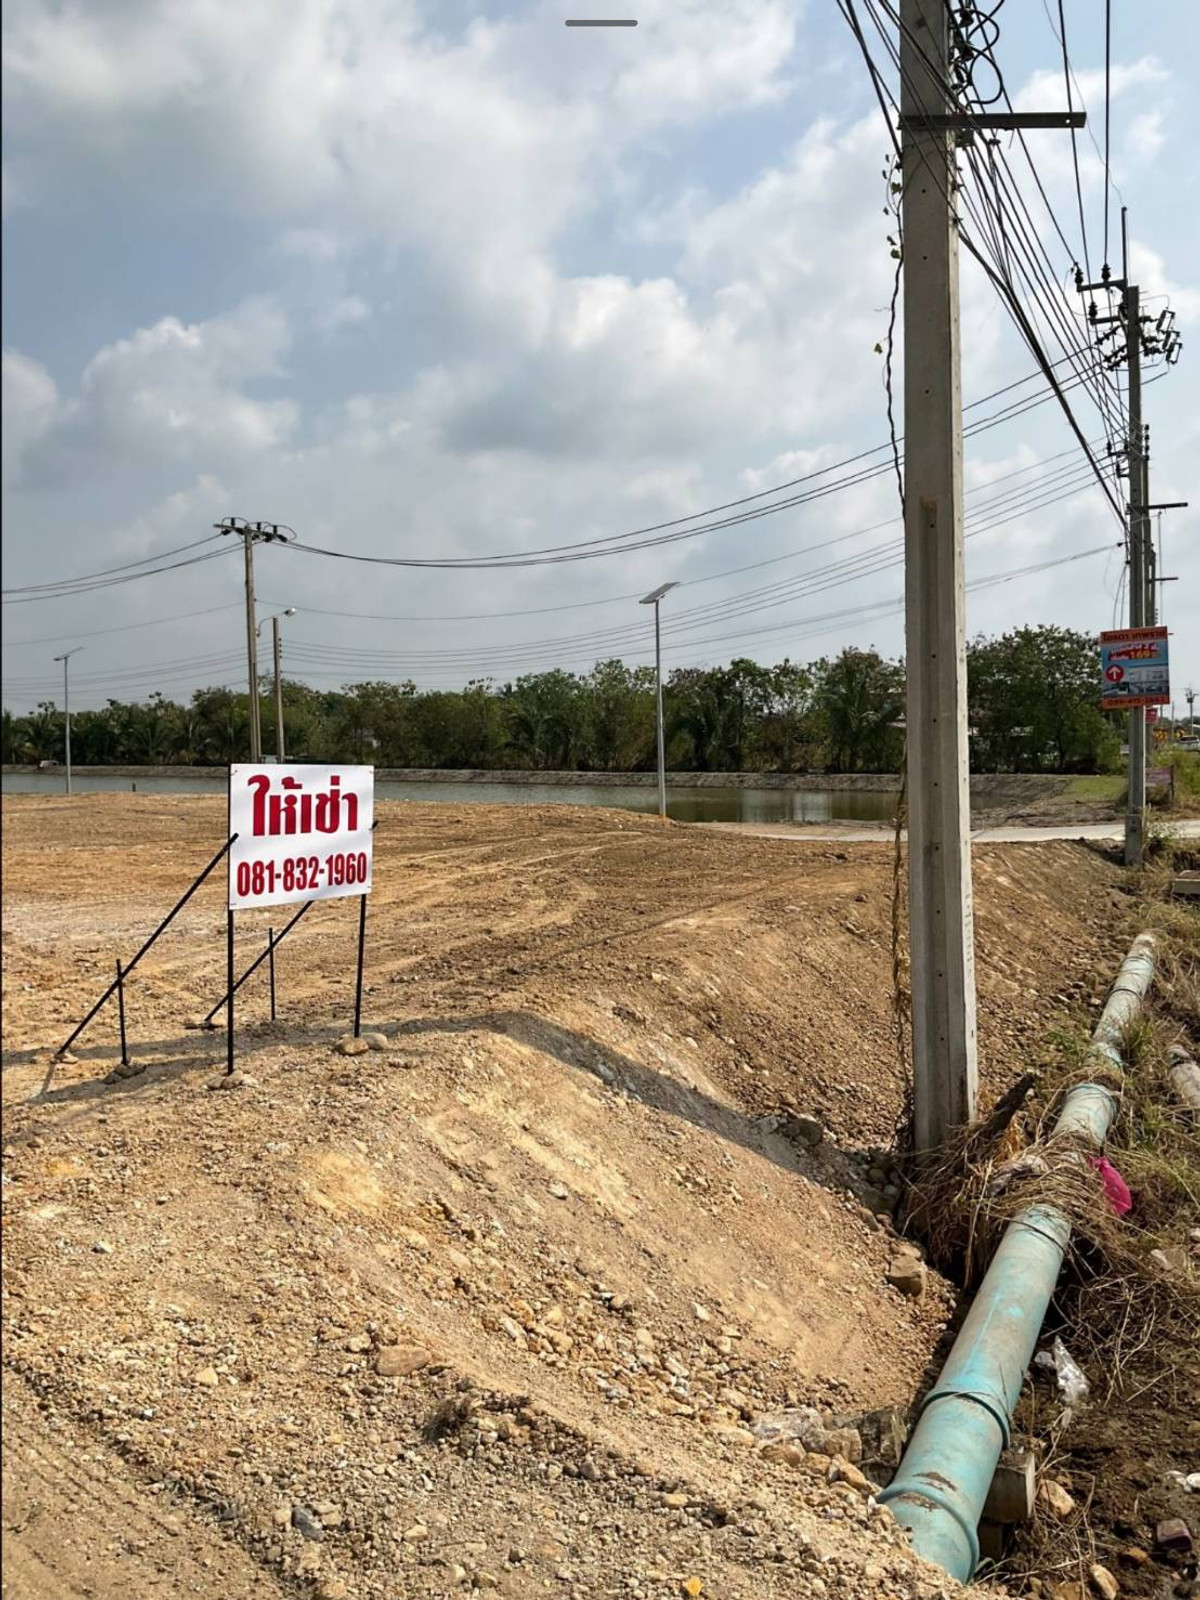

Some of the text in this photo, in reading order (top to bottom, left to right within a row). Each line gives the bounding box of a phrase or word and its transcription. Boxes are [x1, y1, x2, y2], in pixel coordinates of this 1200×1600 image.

[247, 774, 359, 837] ให้เช่า
[236, 852, 367, 897] 081-832-1960
